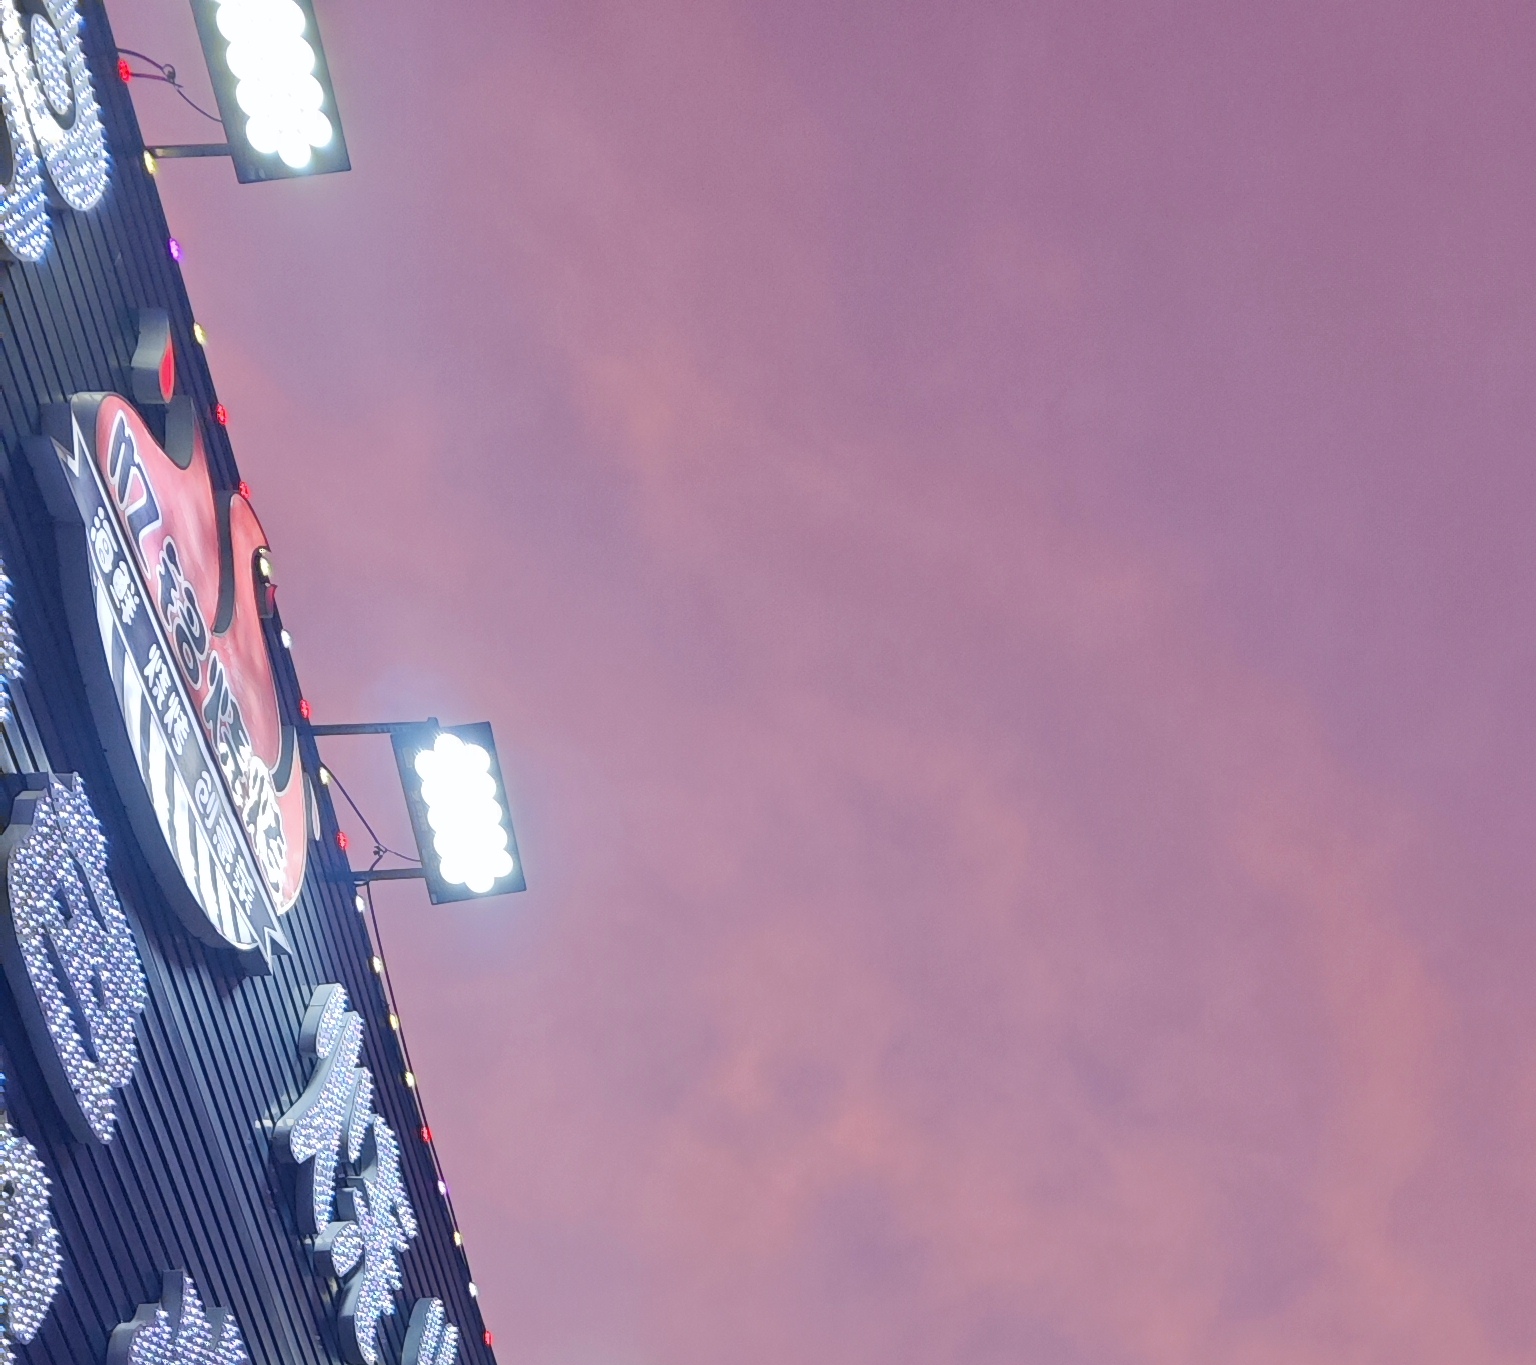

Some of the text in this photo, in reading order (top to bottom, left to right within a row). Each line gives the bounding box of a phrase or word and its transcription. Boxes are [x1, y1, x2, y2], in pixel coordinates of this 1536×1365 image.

[89, 507, 255, 911] 海鲜 烧烤 创意菜
